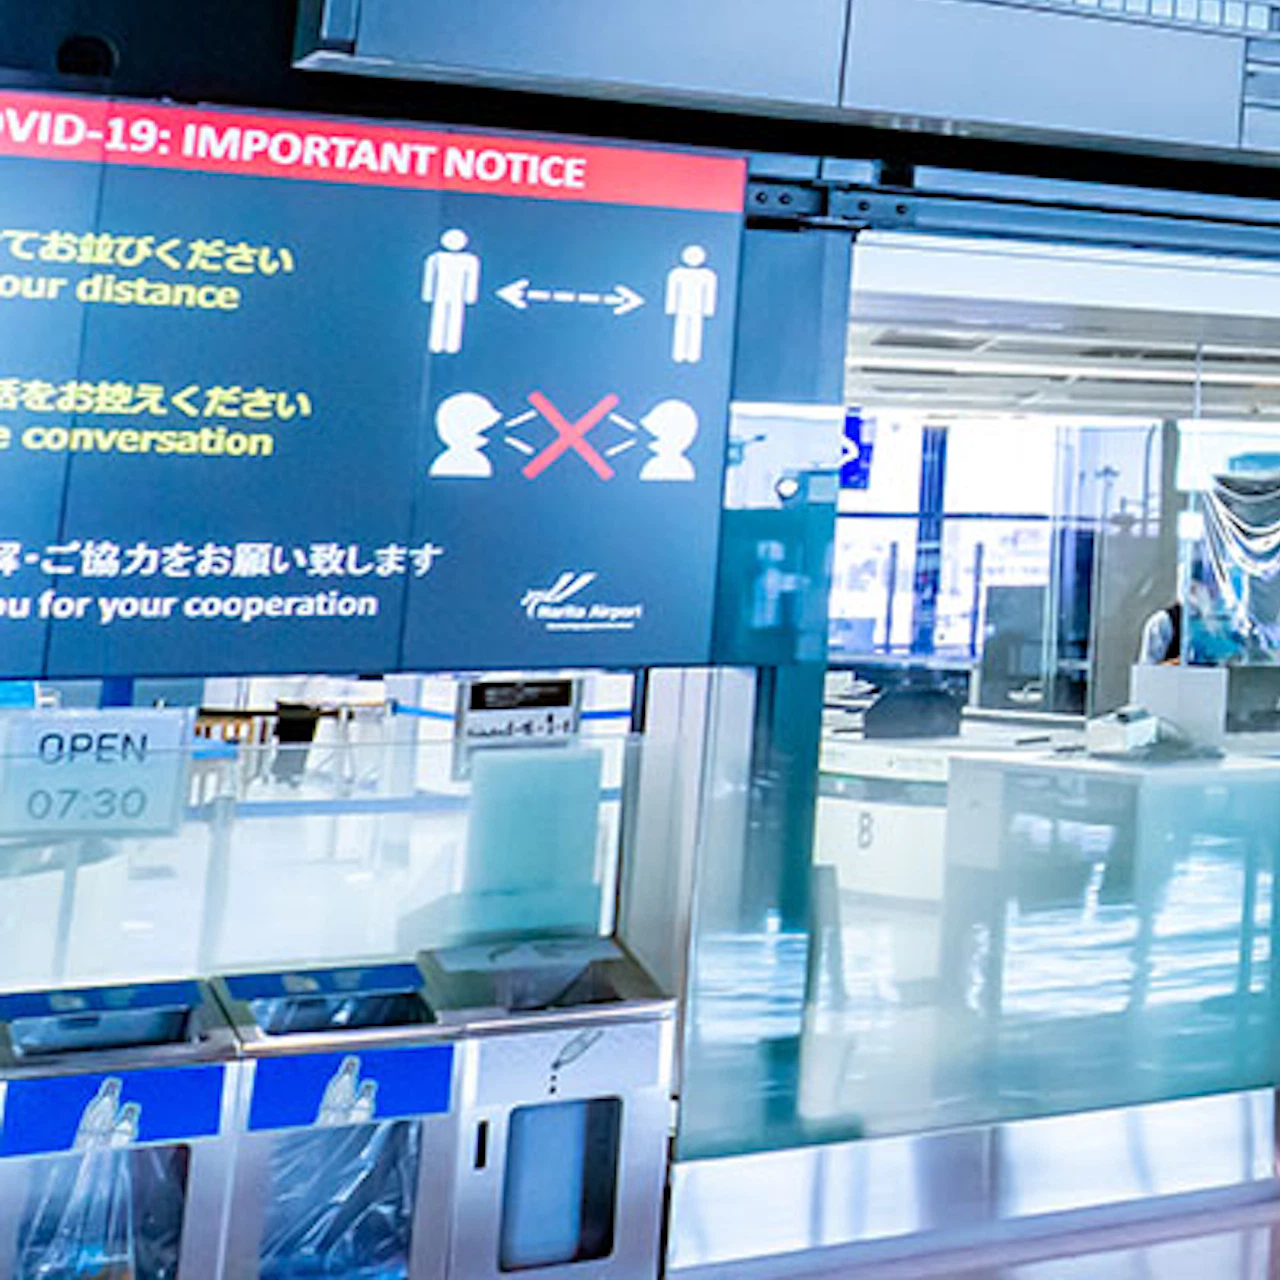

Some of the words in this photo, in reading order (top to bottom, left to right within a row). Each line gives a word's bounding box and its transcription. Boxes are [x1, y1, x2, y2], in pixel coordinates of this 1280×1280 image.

[0, 107, 171, 155] VID-19:
[183, 123, 437, 176] IMPORTANT
[443, 145, 587, 189] NOTICE
[76, 273, 241, 310] distance
[21, 426, 274, 457] conversation
[39, 589, 93, 619] for
[98, 595, 179, 625] your
[183, 590, 379, 622] cooperation
[38, 732, 148, 765] OPEN
[27, 787, 148, 820] 07:30
